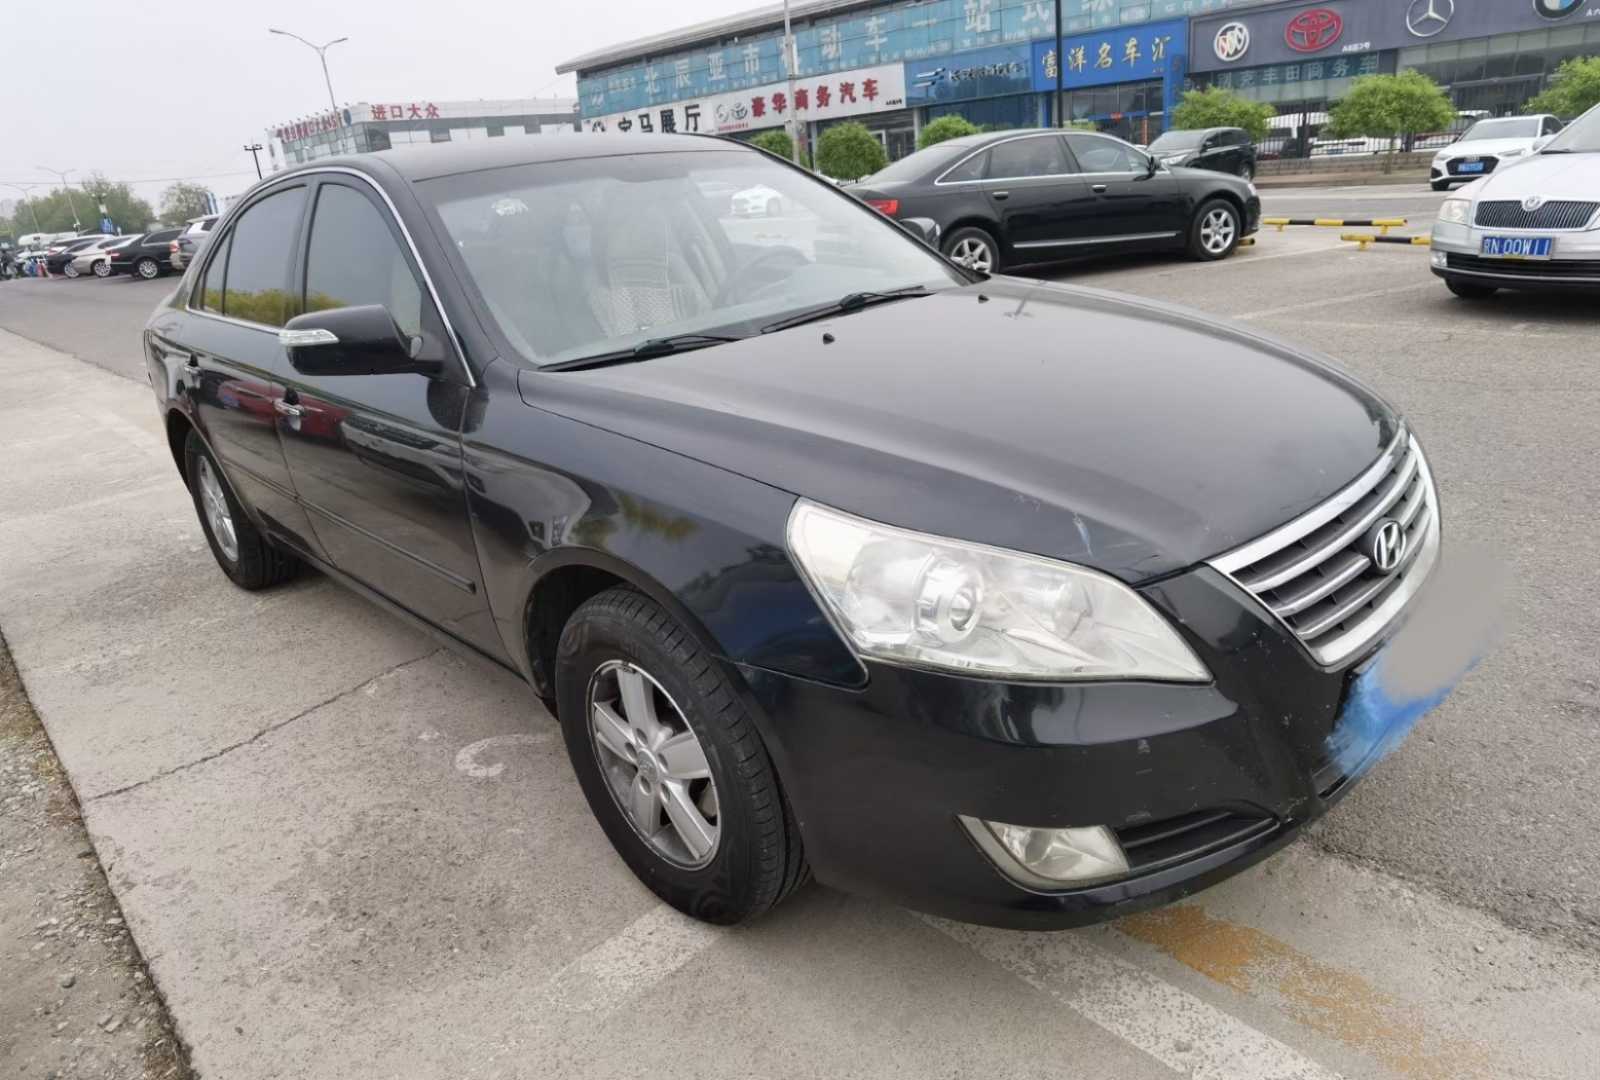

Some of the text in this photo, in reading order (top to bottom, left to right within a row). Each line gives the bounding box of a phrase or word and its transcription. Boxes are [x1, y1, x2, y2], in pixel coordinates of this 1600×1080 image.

[1042, 36, 1171, 80] 富洋名车汇
[371, 102, 440, 120] 进口大众
[751, 78, 880, 118] 豪华商务汽车
